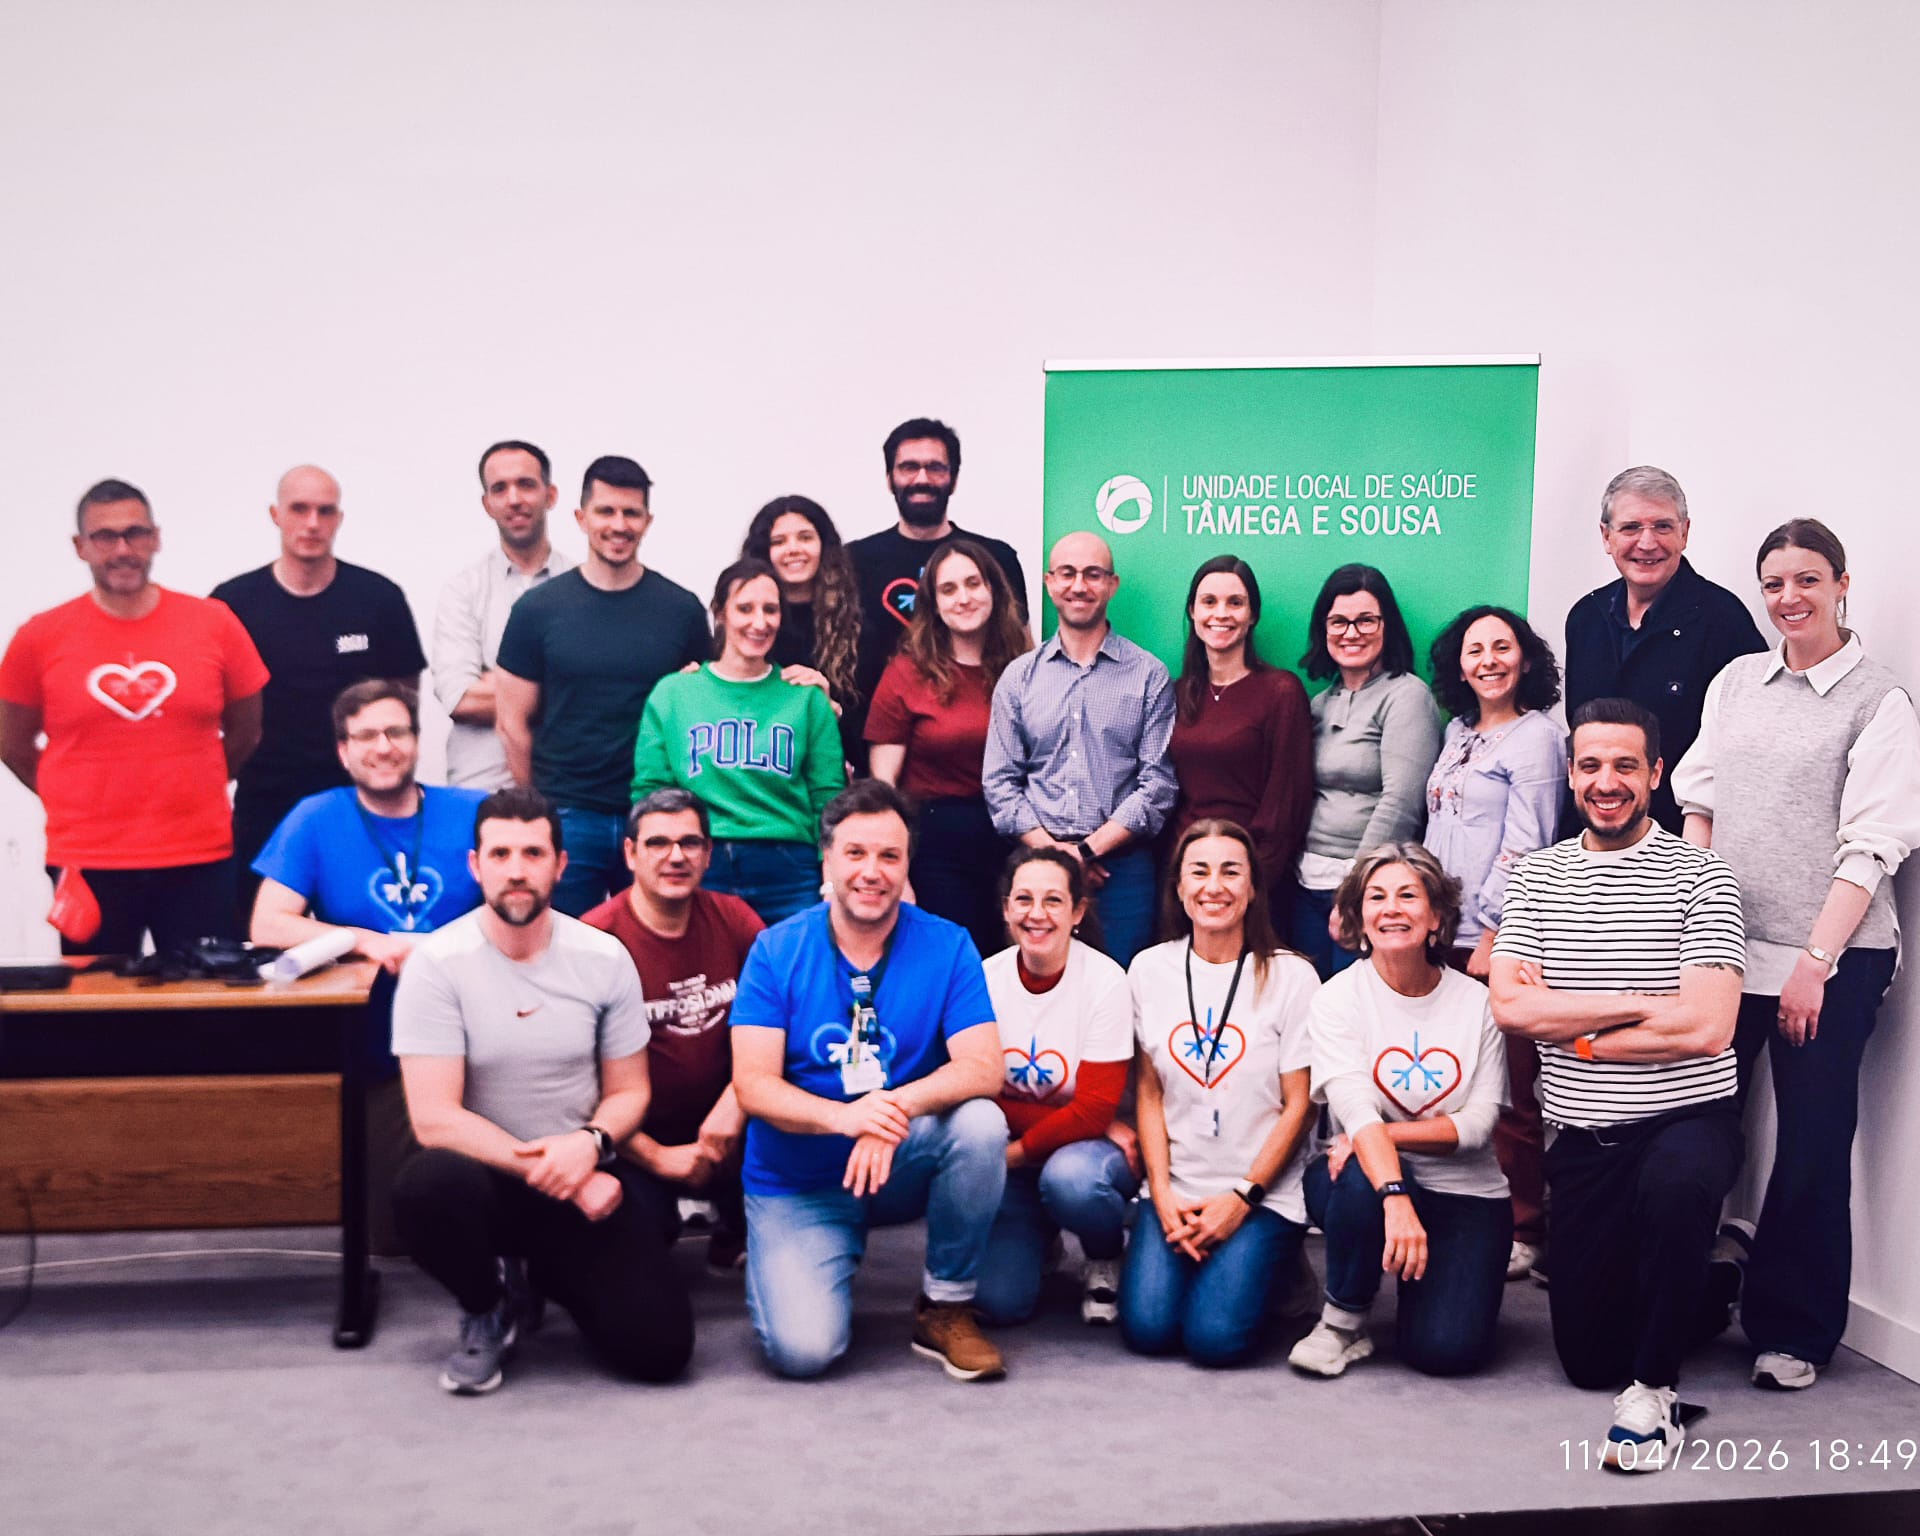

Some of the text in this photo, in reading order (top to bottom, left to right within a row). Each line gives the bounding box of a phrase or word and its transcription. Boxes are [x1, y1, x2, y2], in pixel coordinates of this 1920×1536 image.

[1183, 469, 1477, 499] UNIDADE LOCAL DE SAÚDE
[1181, 499, 1442, 536] TÂMEGA E SOUSA
[688, 718, 794, 778] POLO
